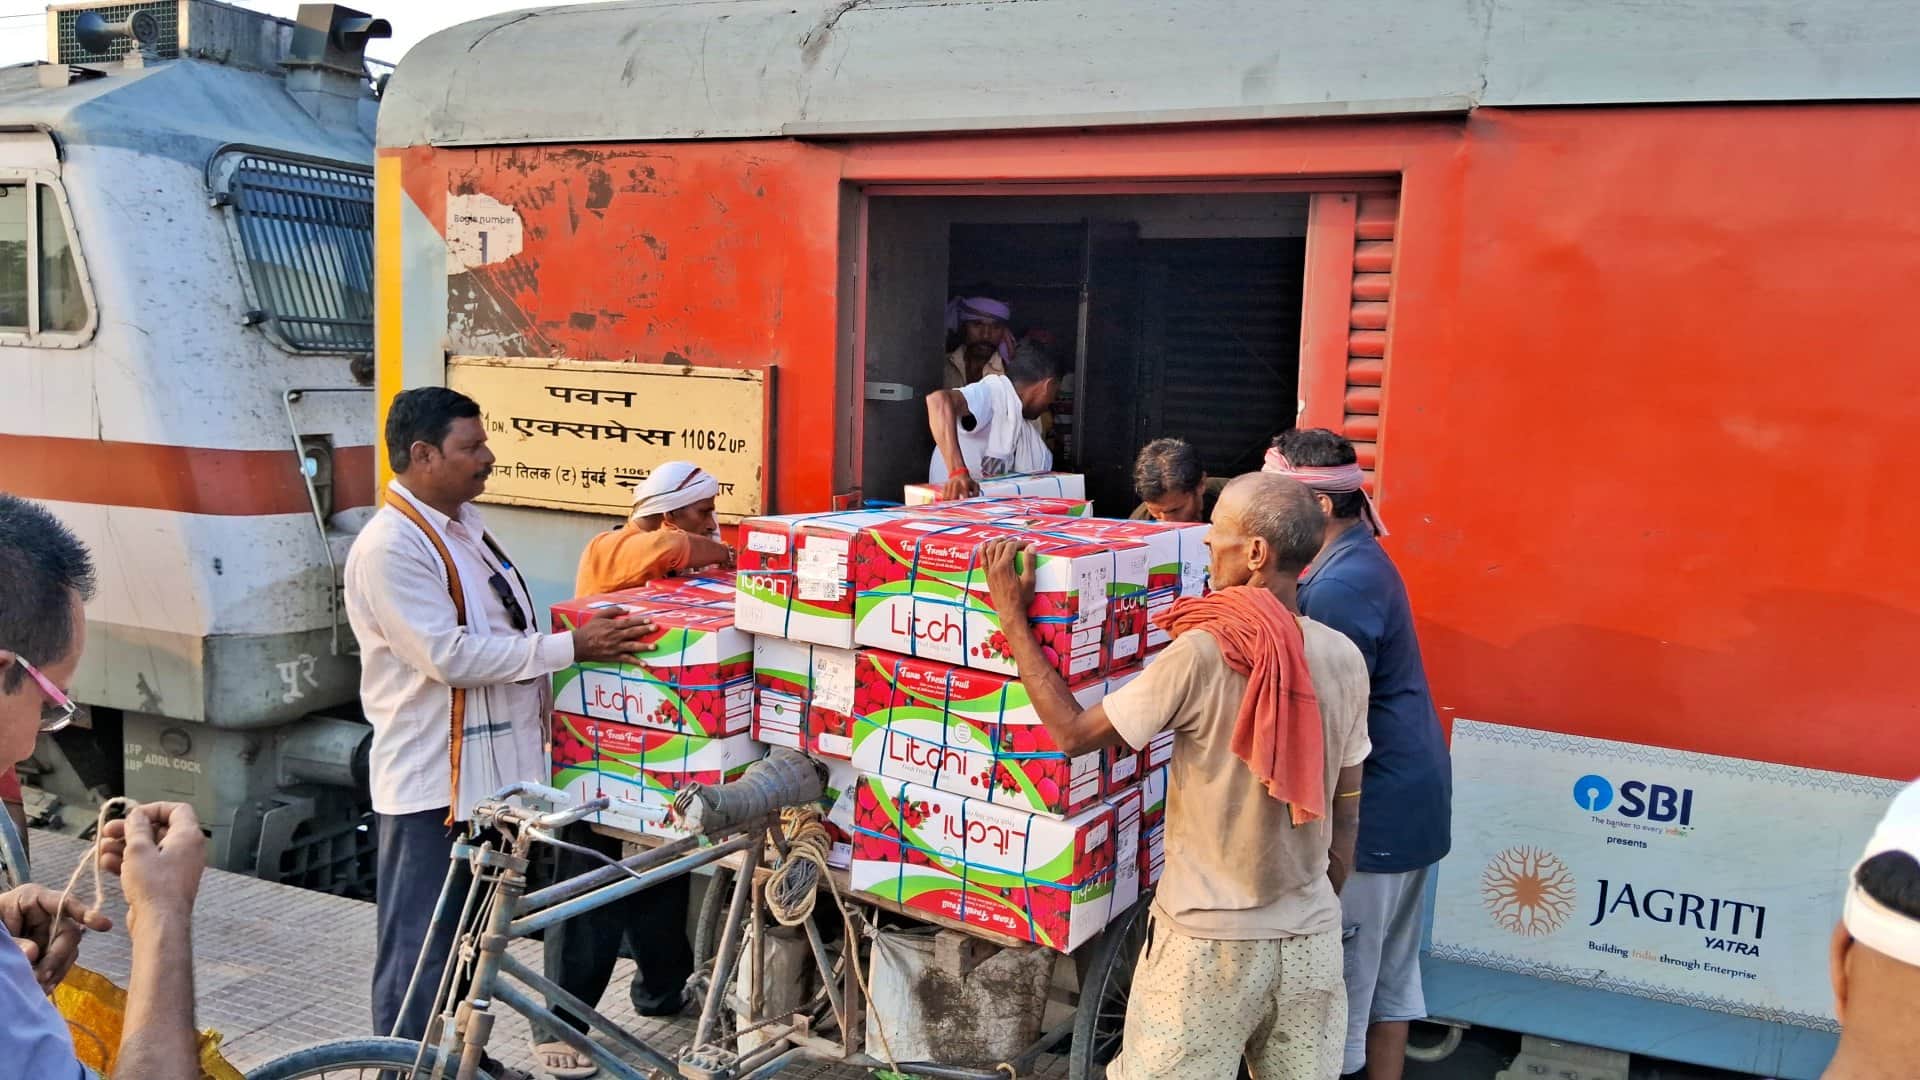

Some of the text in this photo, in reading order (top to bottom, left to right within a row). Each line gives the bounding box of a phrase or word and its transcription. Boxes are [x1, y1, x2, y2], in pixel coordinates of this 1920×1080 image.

[479, 215, 514, 225] number
[478, 231, 488, 264] 1
[544, 386, 638, 408] पवन
[510, 417, 676, 446] एक्सप्रेस
[681, 428, 727, 452] 11062
[516, 461, 552, 480] तिलक
[555, 465, 577, 486] (ट)
[581, 466, 606, 488] मुंबई
[891, 603, 962, 646] Litch
[889, 731, 967, 775] Litchi
[1618, 780, 1693, 826] SBI
[944, 814, 1026, 855] itchi
[1591, 816, 1605, 824] The
[1606, 836, 1648, 849] presents
[1589, 879, 1766, 939] JAGRITI
[1588, 940, 1629, 959] Building
[1659, 954, 1701, 970] through
[1703, 962, 1758, 980] Enterprise
[1704, 936, 1760, 957] YATRA
